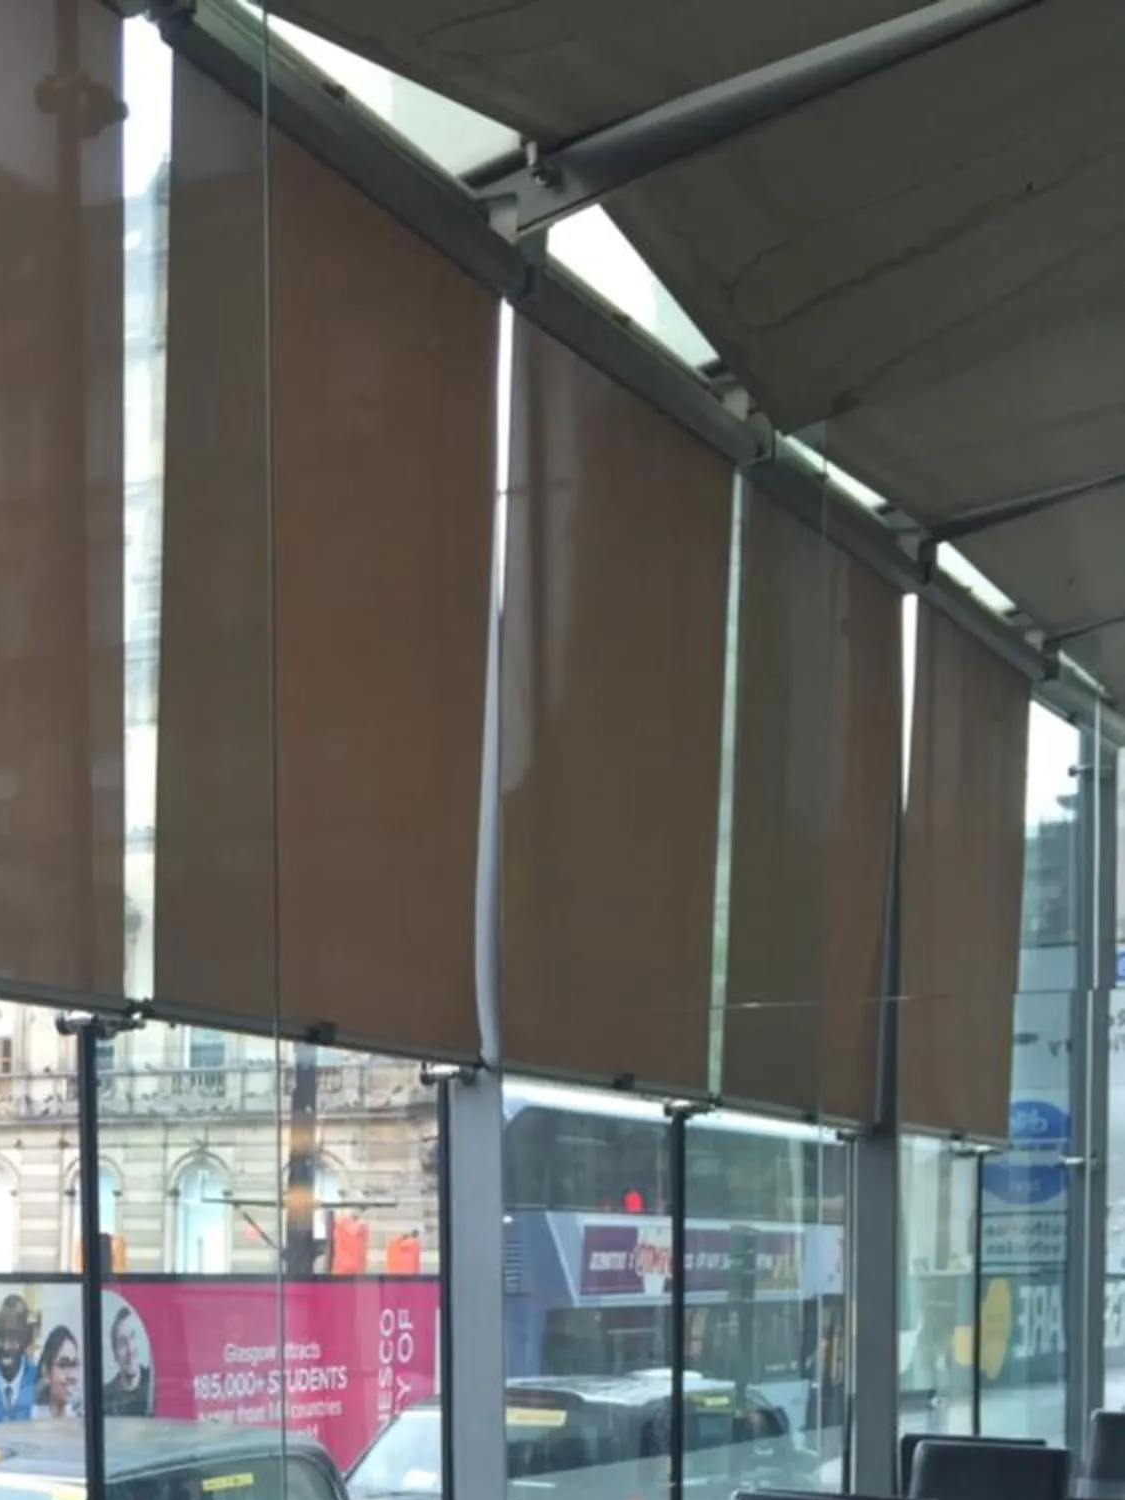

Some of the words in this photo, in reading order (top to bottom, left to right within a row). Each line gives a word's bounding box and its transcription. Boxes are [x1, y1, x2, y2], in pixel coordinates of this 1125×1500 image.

[397, 1308, 413, 1363] OF
[267, 1364, 348, 1395] STUDENTS
[378, 1308, 395, 1427] NESCO
